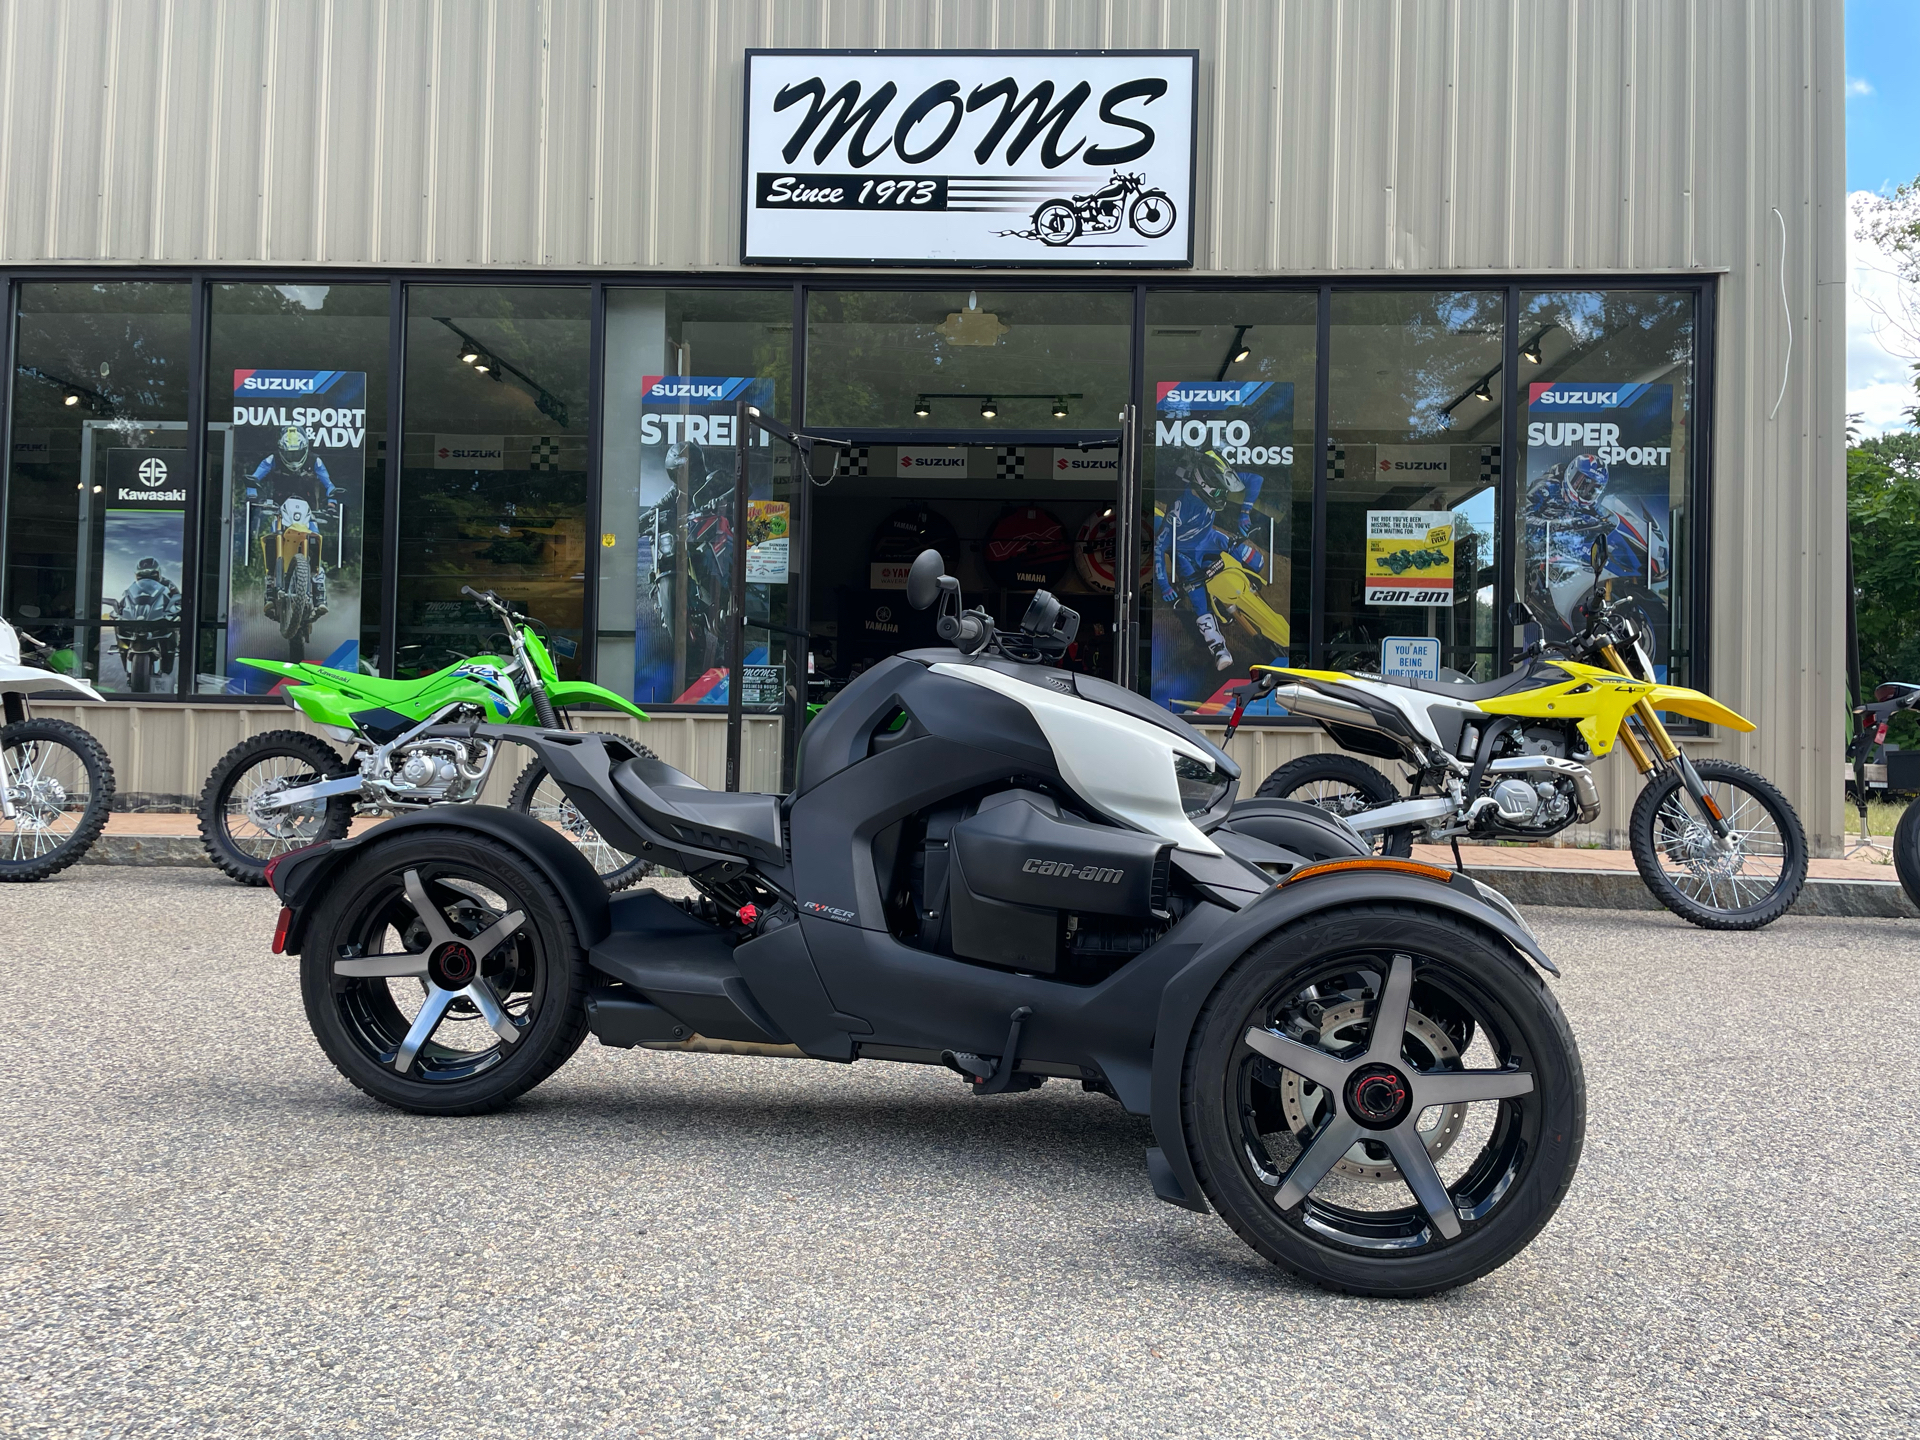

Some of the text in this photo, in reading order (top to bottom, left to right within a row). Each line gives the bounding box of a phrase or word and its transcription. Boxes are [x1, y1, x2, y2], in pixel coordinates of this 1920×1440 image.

[773, 76, 1168, 170] MOMS
[766, 176, 938, 206] Since 1973
[243, 377, 314, 391] SUZUKI
[651, 384, 723, 398] SUZUKI
[1166, 389, 1241, 403] SUZUKI
[1540, 391, 1618, 405] SUZUKI
[641, 413, 770, 447] STRE
[1155, 419, 1251, 447] MOTO
[1527, 422, 1621, 448] SUPER
[452, 449, 501, 458] SUZUKI
[1221, 446, 1294, 465] CROSS
[1597, 446, 1672, 466] SPORT
[915, 457, 965, 467] SUZUKI
[1071, 459, 1118, 469] SUZUK
[1394, 461, 1447, 471] SUZUKI
[118, 487, 187, 502] Kawasaki
[893, 520, 917, 532] YAMAHA
[1431, 535, 1447, 544] EVENT
[1016, 572, 1046, 583] YAMAHA
[1369, 590, 1449, 603] can-am
[425, 601, 461, 611] MOMS
[865, 619, 899, 633] YAMAHA
[1395, 645, 1428, 655] YOU ARE
[1399, 657, 1422, 667] BEING
[316, 667, 351, 683] Kawasaki
[459, 664, 505, 682] KLX
[743, 667, 777, 677] MOMS
[1354, 671, 1382, 680] SUZUKI
[1388, 669, 1433, 679] VIDEOTAPED
[1021, 858, 1125, 884] can-am
[497, 865, 533, 897] KENDA
[803, 901, 856, 918] RYKER
[830, 915, 851, 923] SPORT
[1311, 924, 1361, 951] XPS
[1237, 1196, 1287, 1243] KENDA
